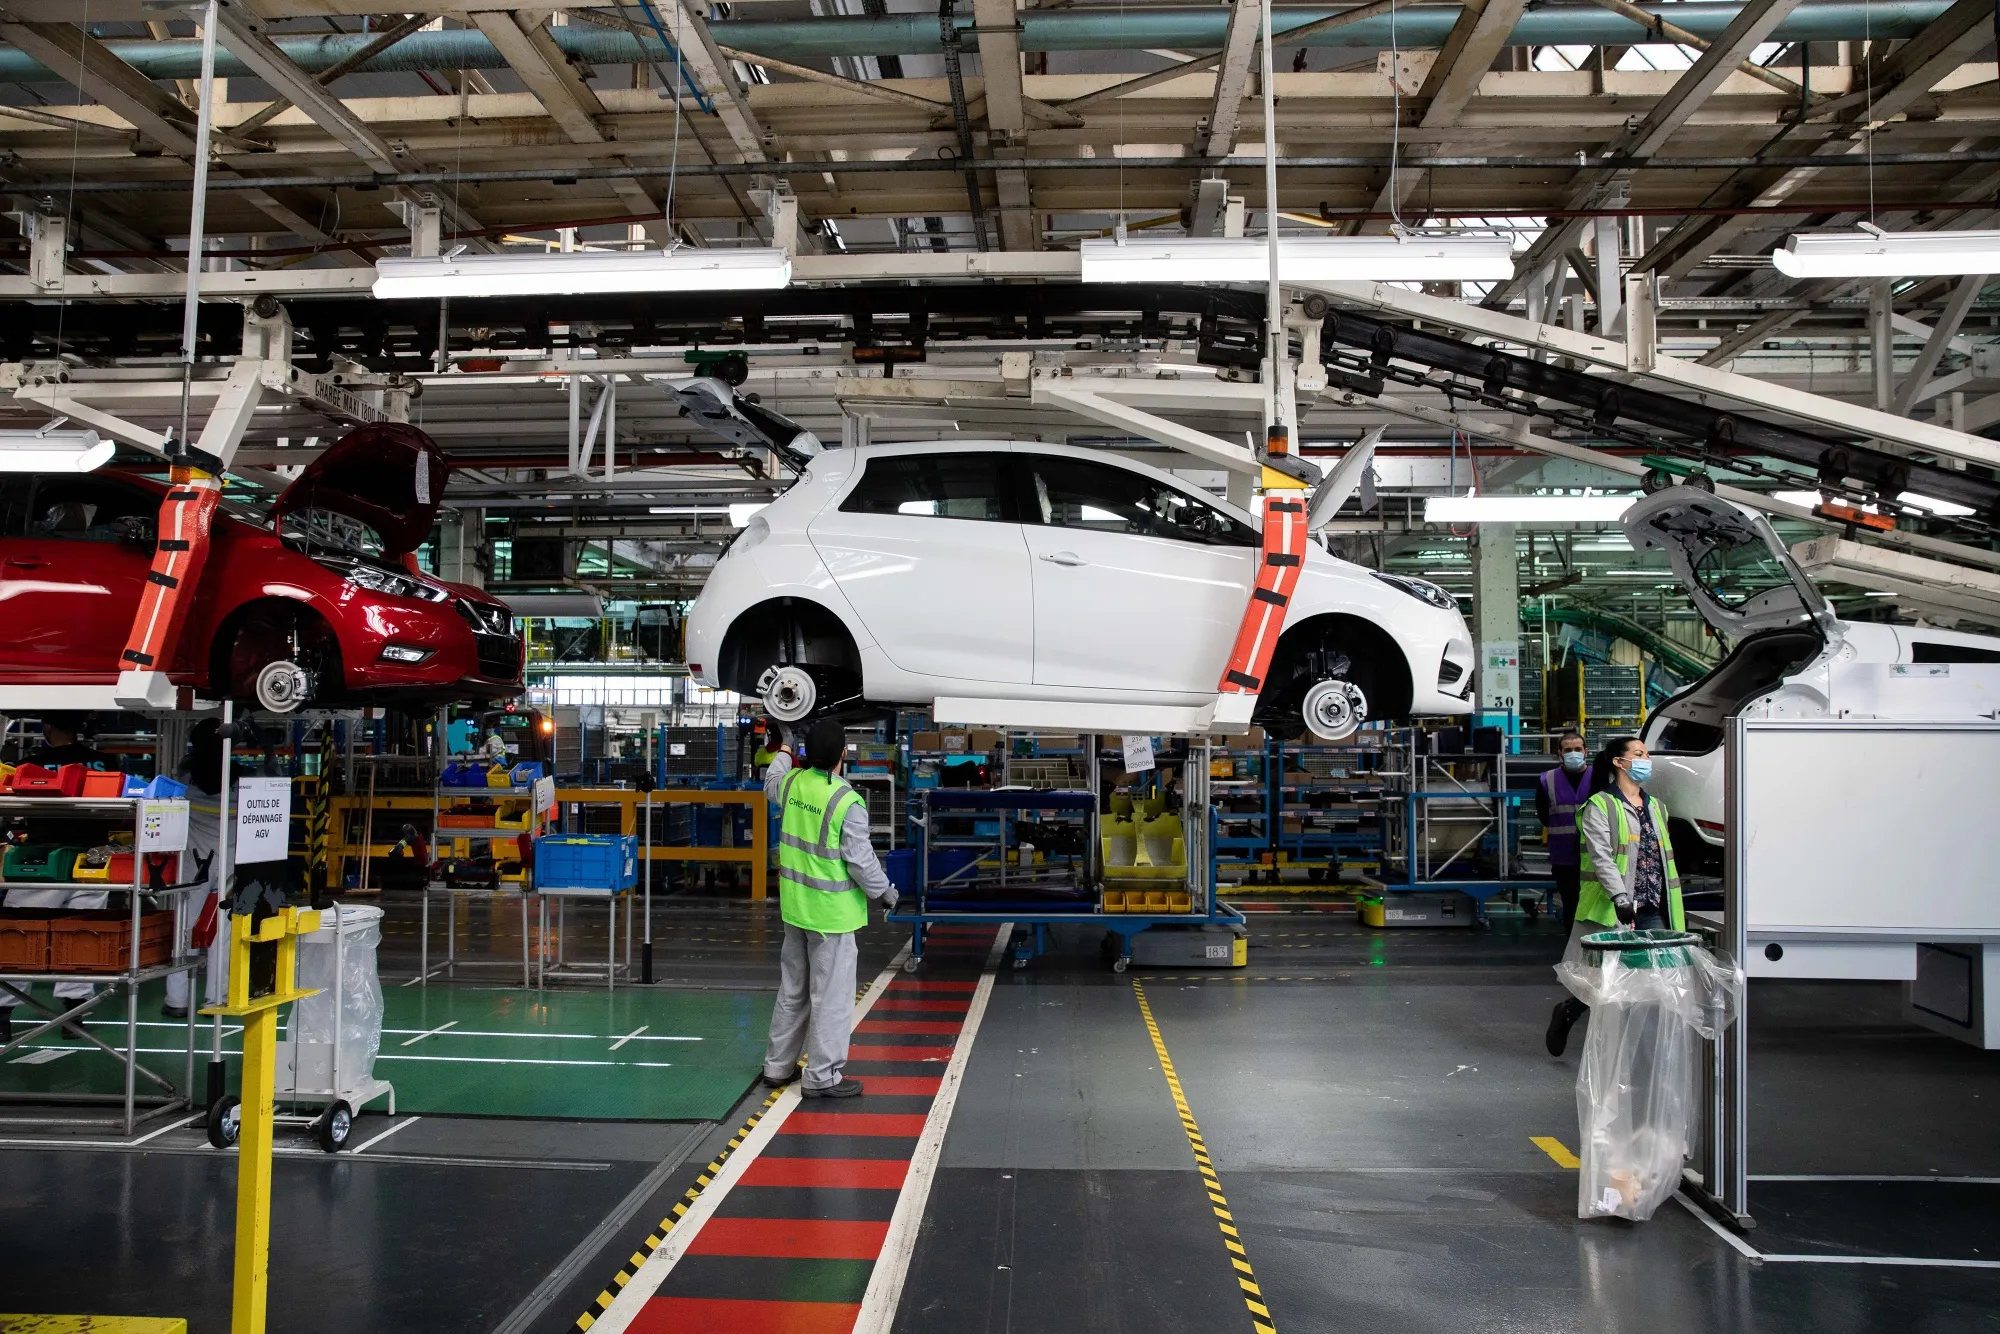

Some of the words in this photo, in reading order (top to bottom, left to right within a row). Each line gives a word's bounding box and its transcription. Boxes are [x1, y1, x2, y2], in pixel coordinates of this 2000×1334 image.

[315, 379, 341, 407] CHARGE
[343, 393, 360, 417] MAXI
[361, 403, 376, 422] 1800
[1494, 696, 1514, 708] 30
[1132, 746, 1147, 755] XNA
[247, 799, 270, 809] OUTILS
[271, 799, 280, 808] DE
[789, 797, 822, 815] CHECKMAN
[242, 812, 283, 825] DÉPANNAGE
[254, 829, 270, 839] AGV
